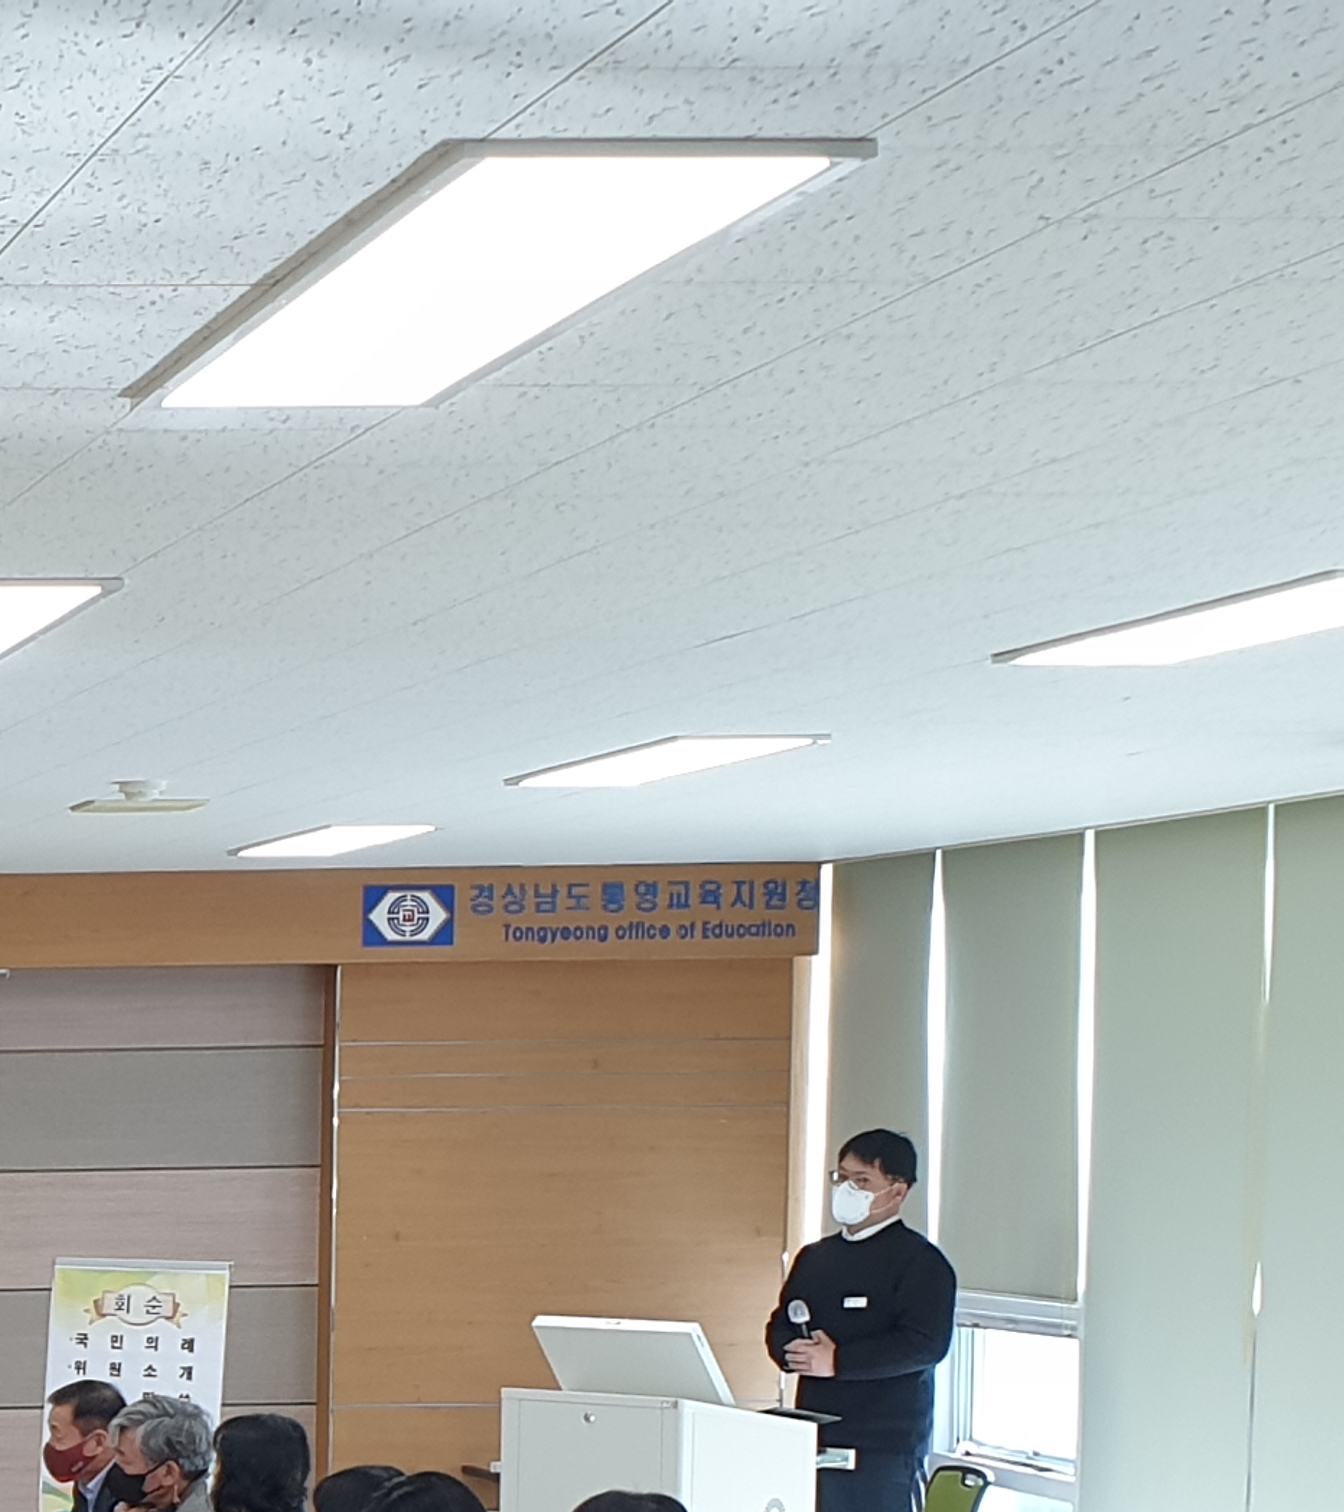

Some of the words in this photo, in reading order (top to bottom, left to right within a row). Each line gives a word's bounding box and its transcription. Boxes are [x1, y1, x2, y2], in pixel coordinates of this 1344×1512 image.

[503, 923, 609, 943] Tongyeong
[615, 921, 671, 940] office
[677, 921, 697, 939] of
[701, 920, 796, 939] Education
